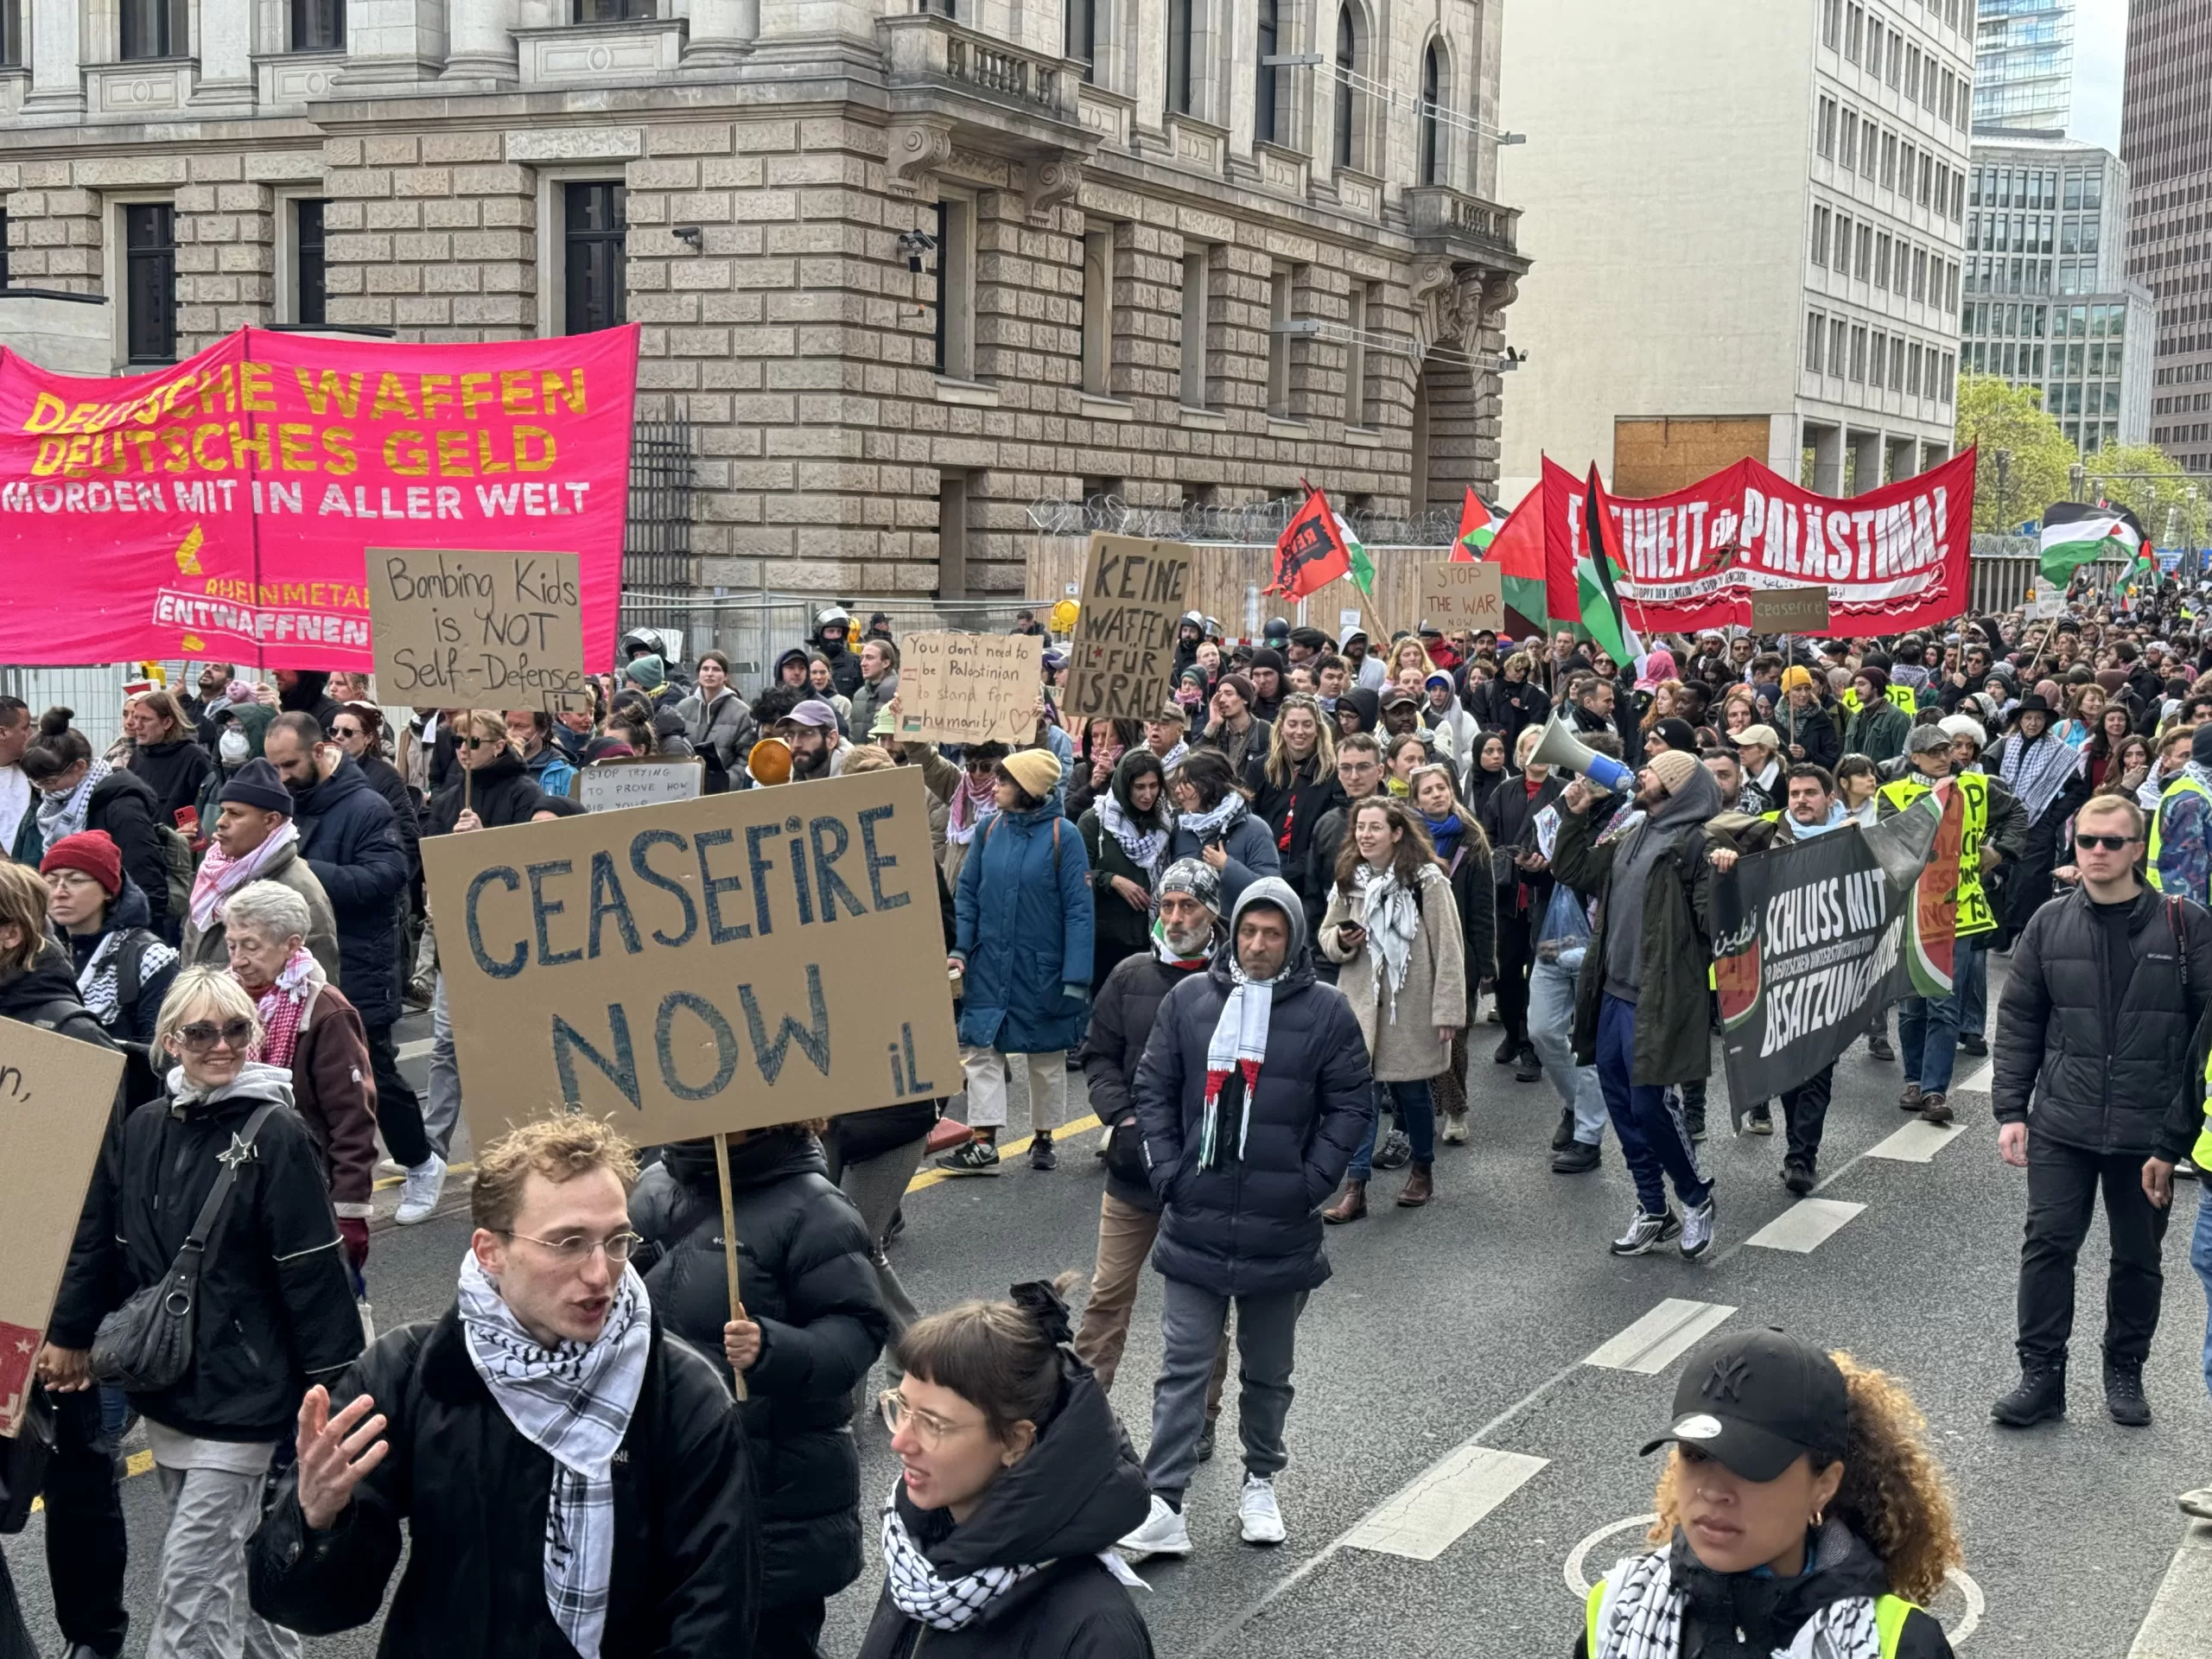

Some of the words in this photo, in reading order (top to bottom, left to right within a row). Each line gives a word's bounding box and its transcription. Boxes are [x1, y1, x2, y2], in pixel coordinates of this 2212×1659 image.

[23, 361, 276, 434] DEUTSCHE
[294, 367, 588, 419] WAFFEN
[30, 422, 359, 477] DEUTSCHES
[383, 425, 556, 477] GELD
[1, 480, 167, 514] MORDEN
[173, 480, 238, 514] MIT
[251, 480, 302, 514] IN
[318, 483, 464, 519] ALLER
[474, 481, 590, 518] WELT
[1567, 493, 1709, 580] FIHEIT
[1739, 486, 1949, 581] PALÄSTINA!
[386, 553, 495, 620] Bombing
[515, 557, 578, 607] Kids
[1094, 543, 1188, 604] KEINE
[1438, 566, 1481, 588] STOP
[159, 594, 368, 645] ENTWAFFNEN
[1426, 595, 1452, 612] THE
[1462, 594, 1497, 615] WAR
[1447, 618, 1472, 626] NOW
[432, 607, 461, 643] is
[483, 610, 560, 651] NOT
[910, 637, 939, 654] You
[986, 645, 1012, 658] need
[1016, 643, 1028, 659] to
[1084, 604, 1179, 651] WAFFEN
[393, 646, 582, 694] Self-Defense
[923, 662, 937, 675] be
[950, 660, 1019, 681] Palestinian
[1106, 643, 1157, 676] FÜR
[918, 684, 930, 700] to
[938, 683, 976, 702] stand
[988, 687, 1013, 702] for
[1074, 672, 1165, 719] ISRAEL
[588, 768, 620, 780] STOP
[628, 767, 672, 778] TRYING
[588, 787, 603, 796] TO
[615, 783, 655, 794] PROVE
[667, 782, 688, 791] HOW
[1764, 875, 1844, 961] SCHLUSS
[1844, 866, 1887, 932] MIT
[552, 963, 831, 1113] NOW
